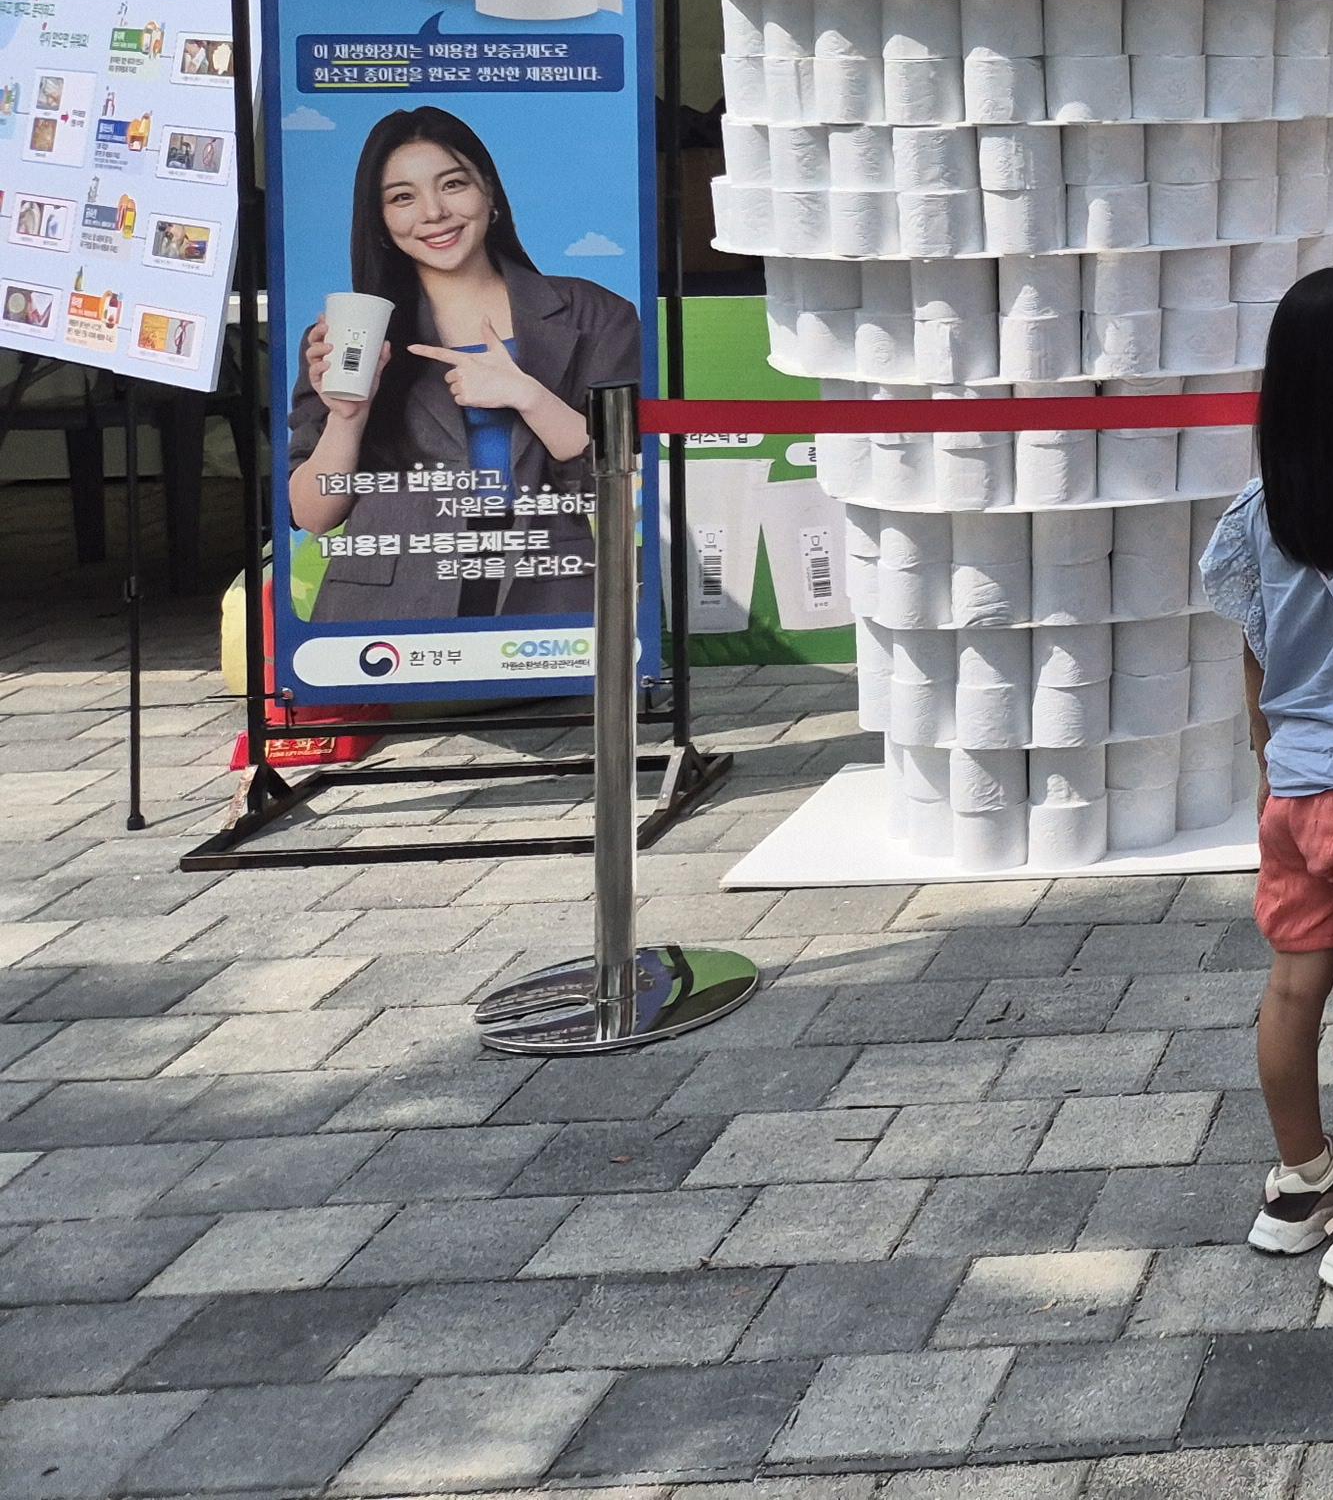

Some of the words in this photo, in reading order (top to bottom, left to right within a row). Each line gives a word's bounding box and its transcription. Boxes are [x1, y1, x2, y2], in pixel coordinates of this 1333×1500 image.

[313, 44, 328, 59] 이
[333, 43, 424, 59] 재생화장지는
[483, 43, 569, 59] 보증금제도로
[313, 67, 358, 83] 회수된
[364, 67, 423, 83] 종이컵을
[428, 67, 472, 82] 원료로
[476, 66, 521, 82] 생산한
[317, 471, 399, 496] 1회용컵
[436, 496, 506, 518] 자원은
[317, 534, 401, 558] 1회용컵
[408, 529, 550, 554] 보증금제도로
[436, 558, 506, 581] 환경을
[409, 650, 462, 666] 환경부
[501, 639, 590, 658] COSMO
